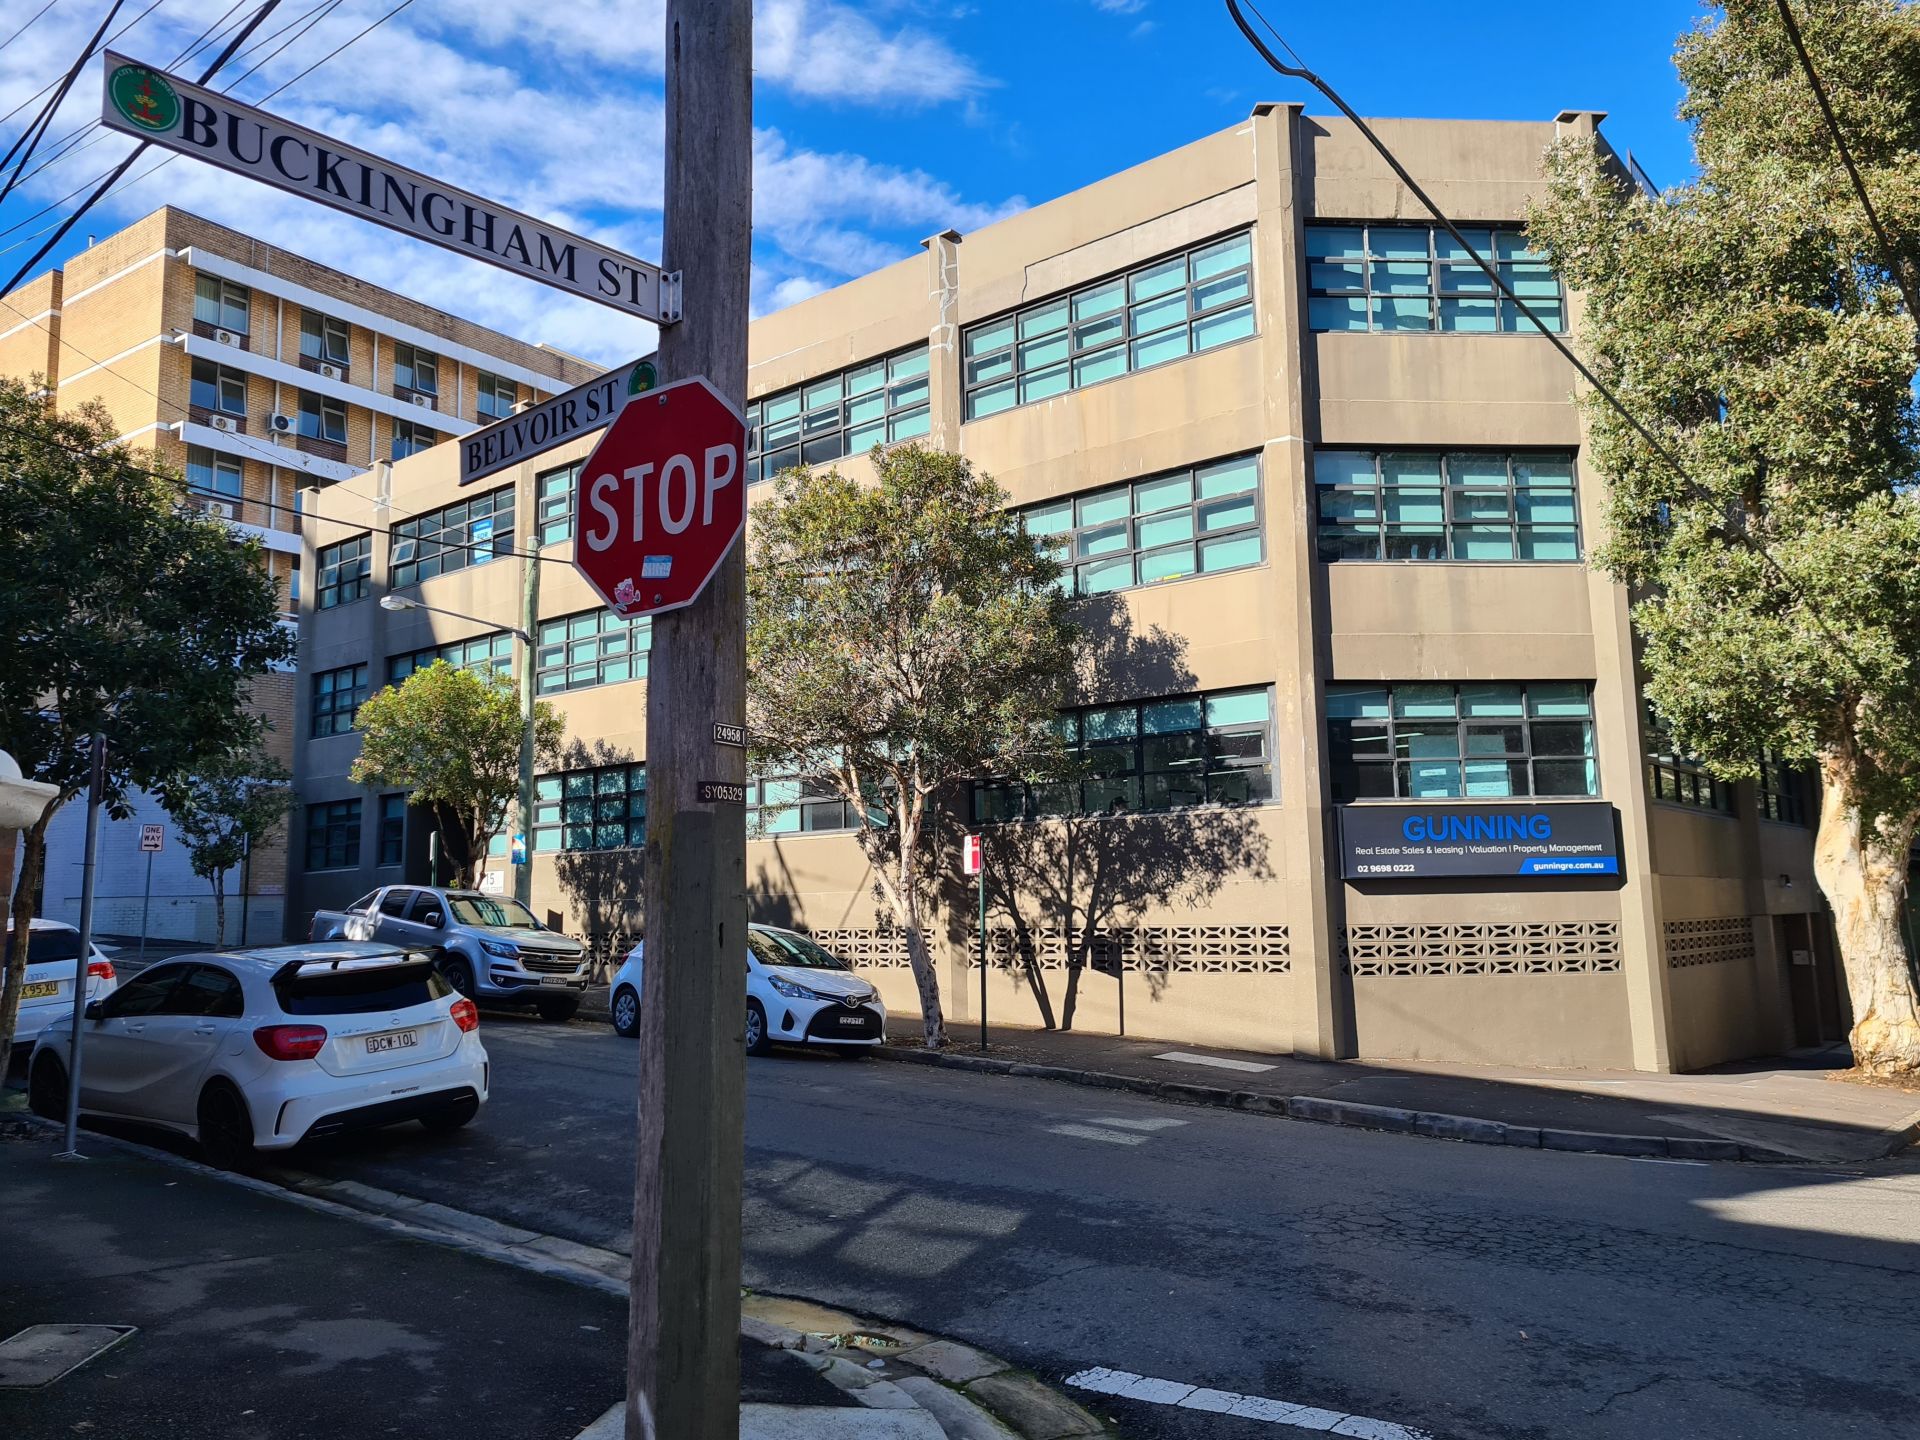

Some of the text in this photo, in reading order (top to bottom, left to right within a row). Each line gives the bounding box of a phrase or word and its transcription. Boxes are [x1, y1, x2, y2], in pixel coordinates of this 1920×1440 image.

[177, 92, 648, 307] BUCKINGHAM ST
[467, 379, 619, 474] BELVOIR ST
[586, 443, 737, 552] STOP
[717, 726, 741, 742] 24958
[705, 785, 743, 801] SY05329
[145, 826, 161, 834] ONE
[1402, 814, 1552, 841] GUNNING
[144, 834, 161, 842] WAY
[1355, 846, 1374, 855] Real
[1375, 846, 1400, 855] Estate
[1401, 846, 1425, 855] Sales
[1426, 845, 1433, 854] &
[1469, 844, 1508, 854] Valuation
[1513, 843, 1548, 854] Property
[1549, 843, 1603, 853] Management
[1357, 864, 1416, 873] 02 9698 0222
[1533, 862, 1605, 871] gunningre.com.au
[486, 872, 495, 885] 15
